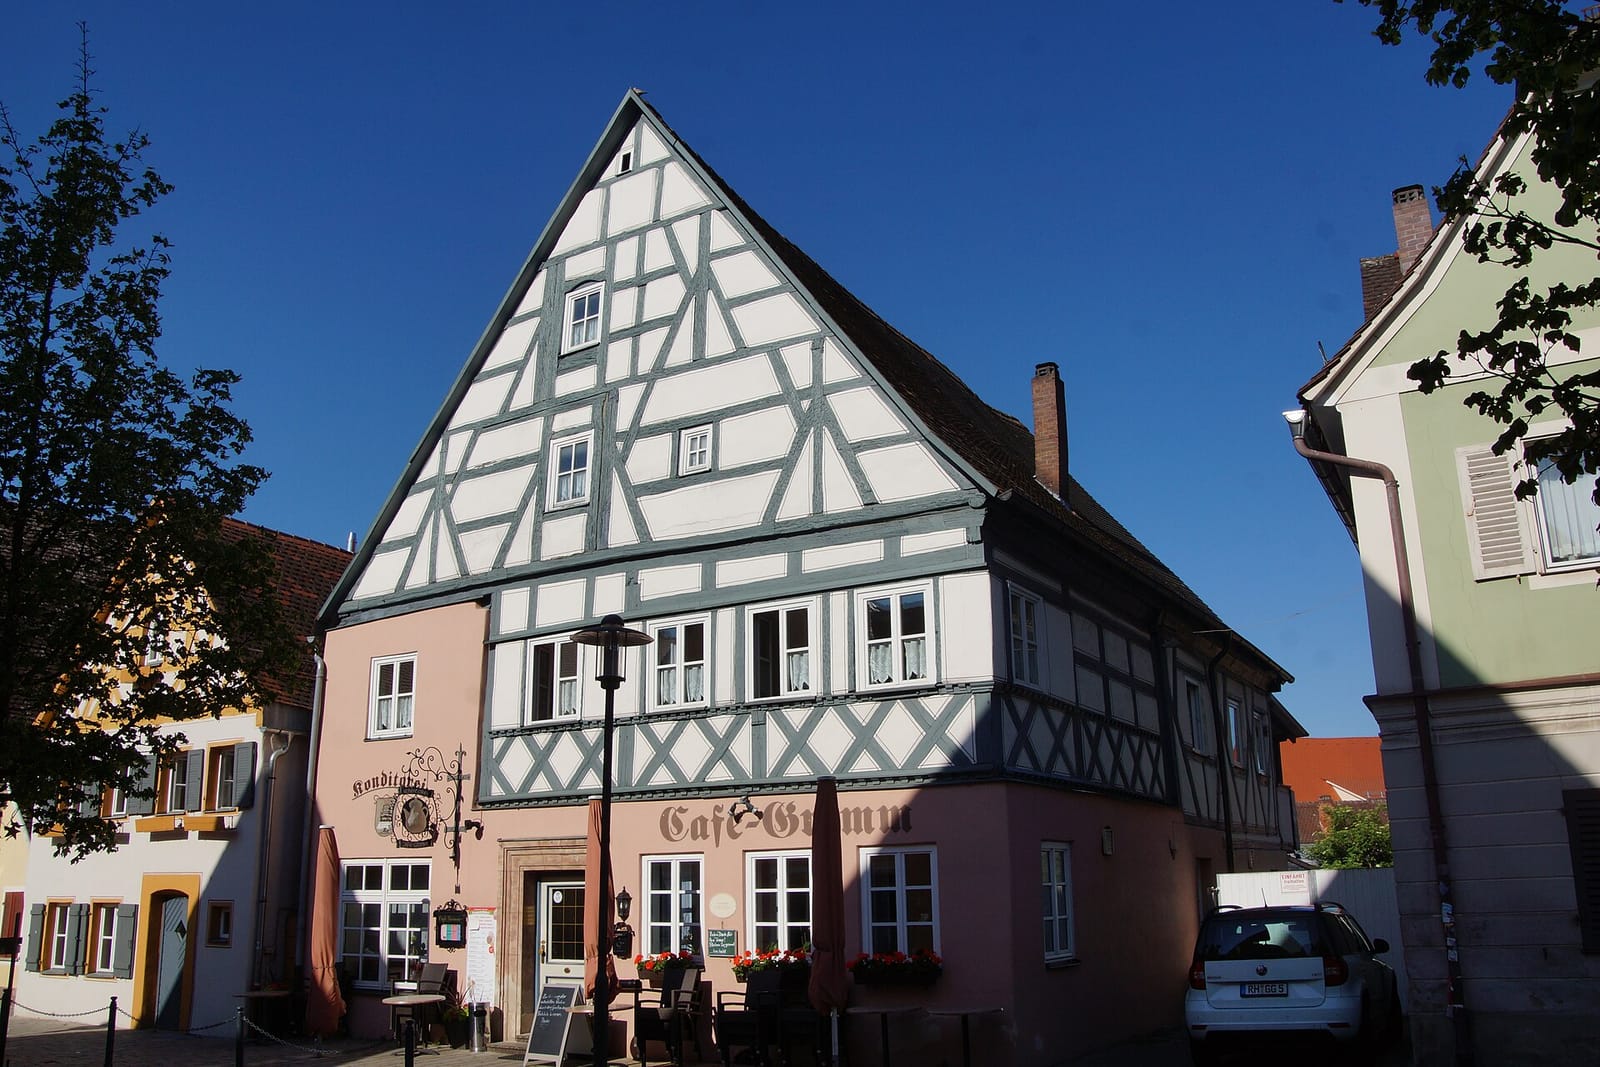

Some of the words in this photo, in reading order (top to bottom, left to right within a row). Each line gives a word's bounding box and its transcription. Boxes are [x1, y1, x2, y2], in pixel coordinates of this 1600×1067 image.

[659, 801, 913, 848] Cafe-Grmm
[1247, 985, 1260, 994] RH
[1264, 984, 1277, 993] GG
